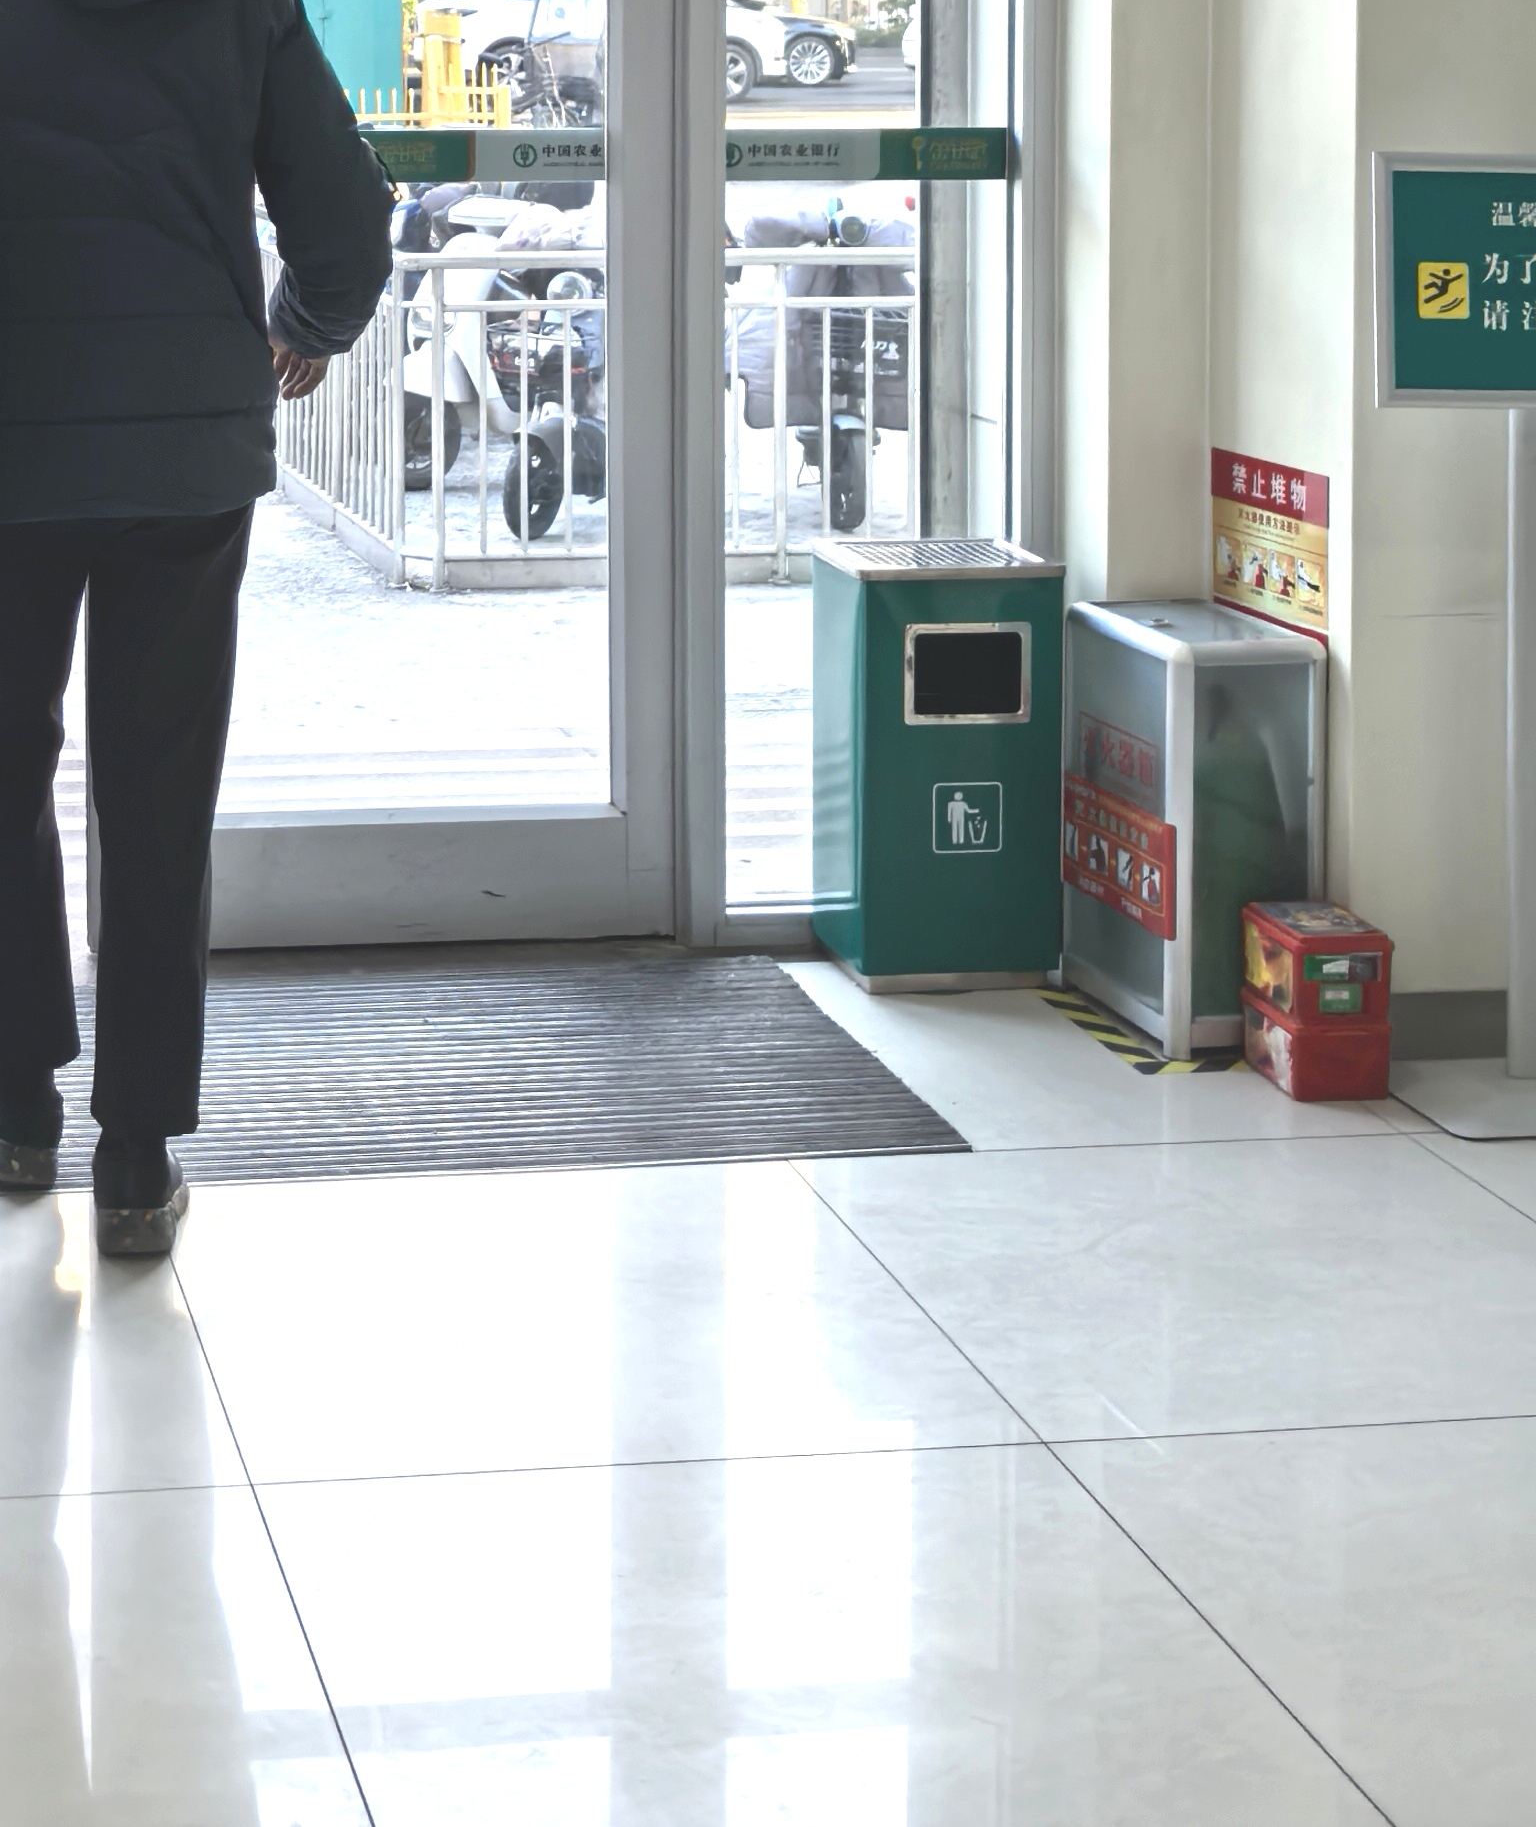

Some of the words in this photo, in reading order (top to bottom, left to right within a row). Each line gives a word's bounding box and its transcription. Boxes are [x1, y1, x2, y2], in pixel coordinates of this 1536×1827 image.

[542, 144, 602, 158] 中国农业
[747, 142, 840, 158] 中国农业银行
[1482, 253, 1536, 284] 为了
[1232, 463, 1306, 512] 禁止堆物
